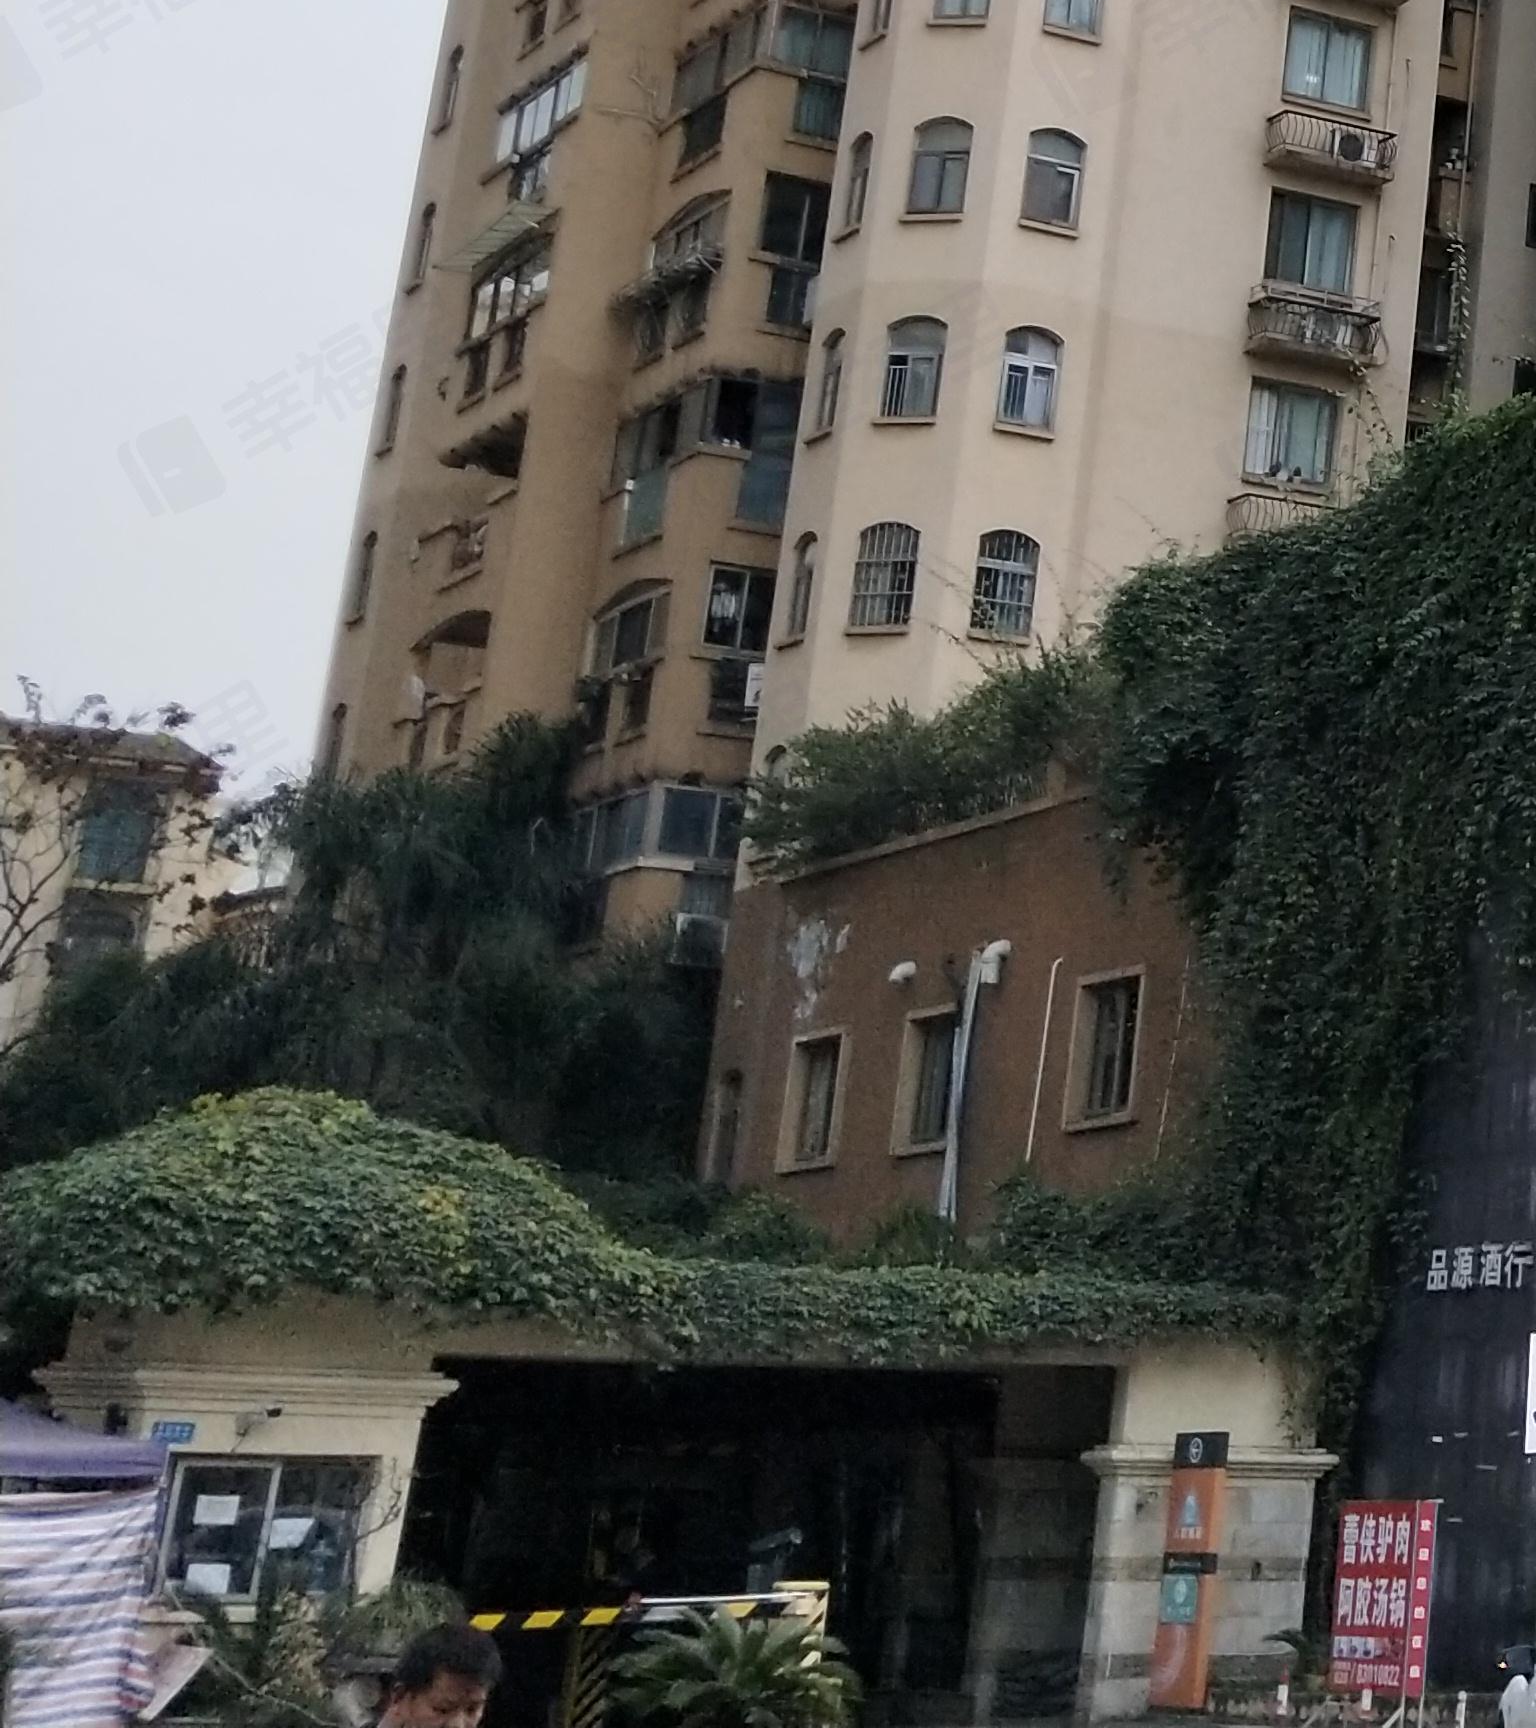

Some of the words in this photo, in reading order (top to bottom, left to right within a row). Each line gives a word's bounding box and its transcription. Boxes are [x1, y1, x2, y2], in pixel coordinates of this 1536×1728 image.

[1425, 1241, 1534, 1292] 品源酒行
[1337, 1575, 1407, 1628] 阿胶汤锅
